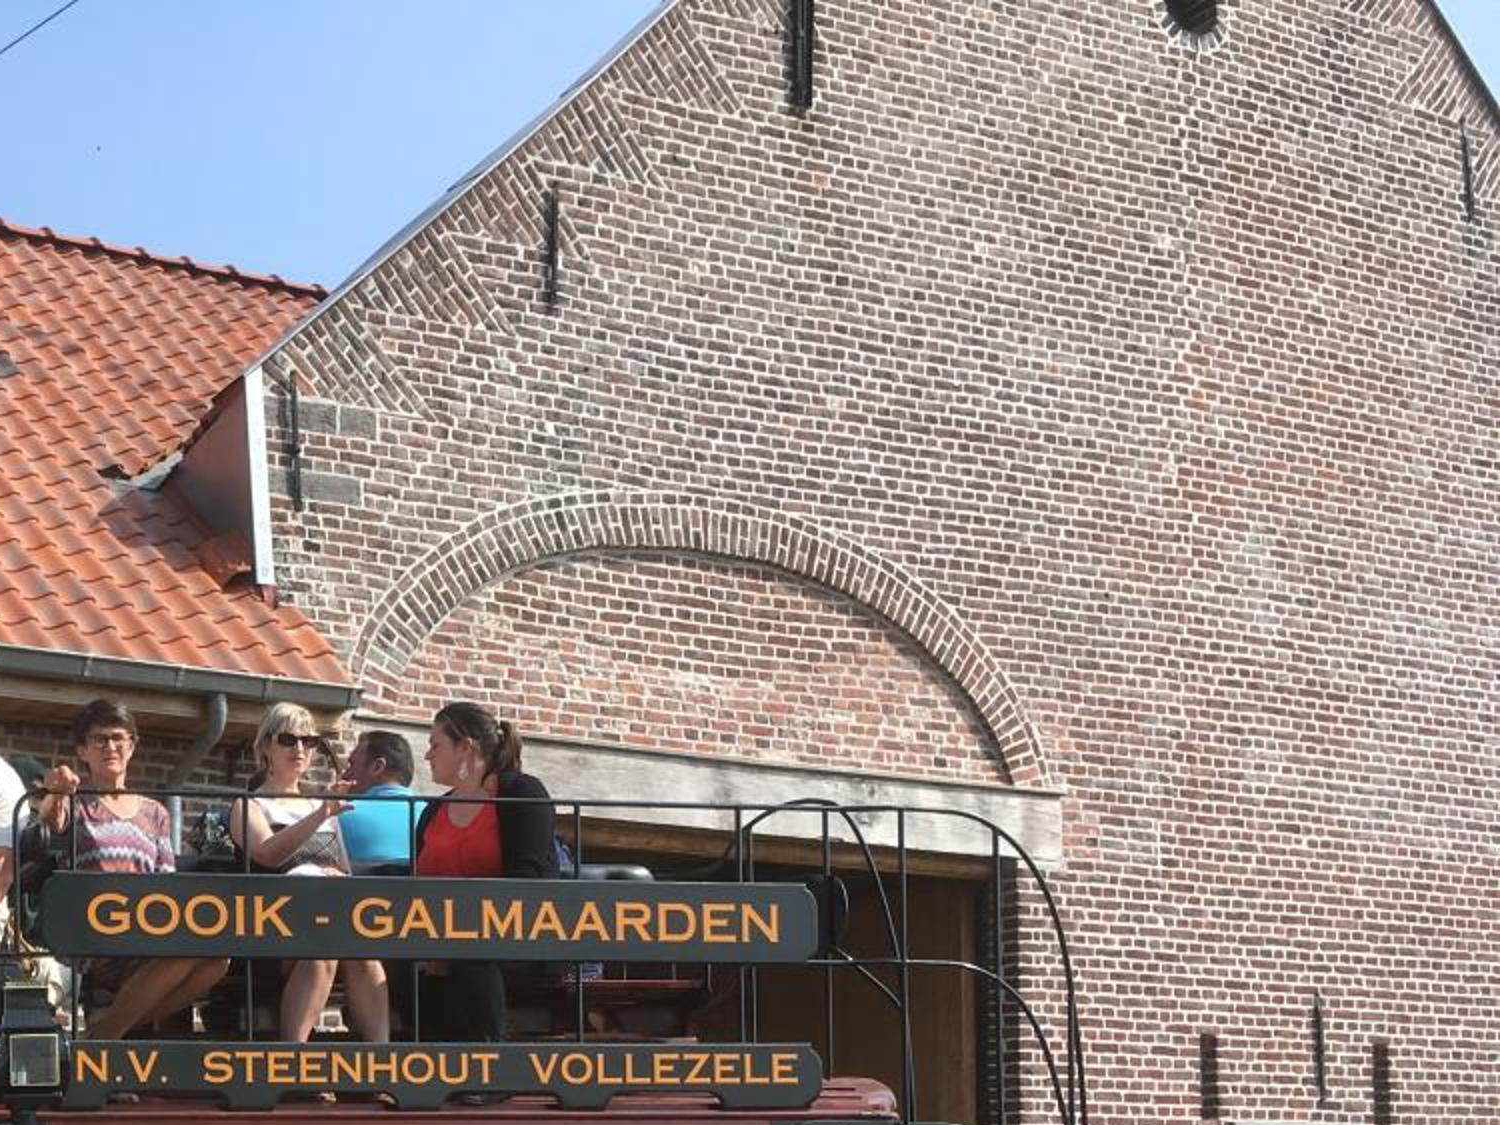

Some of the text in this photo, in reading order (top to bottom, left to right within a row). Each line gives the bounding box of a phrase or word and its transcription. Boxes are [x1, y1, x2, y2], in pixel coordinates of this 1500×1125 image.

[87, 892, 292, 937] GOOIK
[351, 897, 779, 943] GALMAARDEN
[76, 1050, 798, 1085] N.V. STEENHOUT VOLLEZELE
